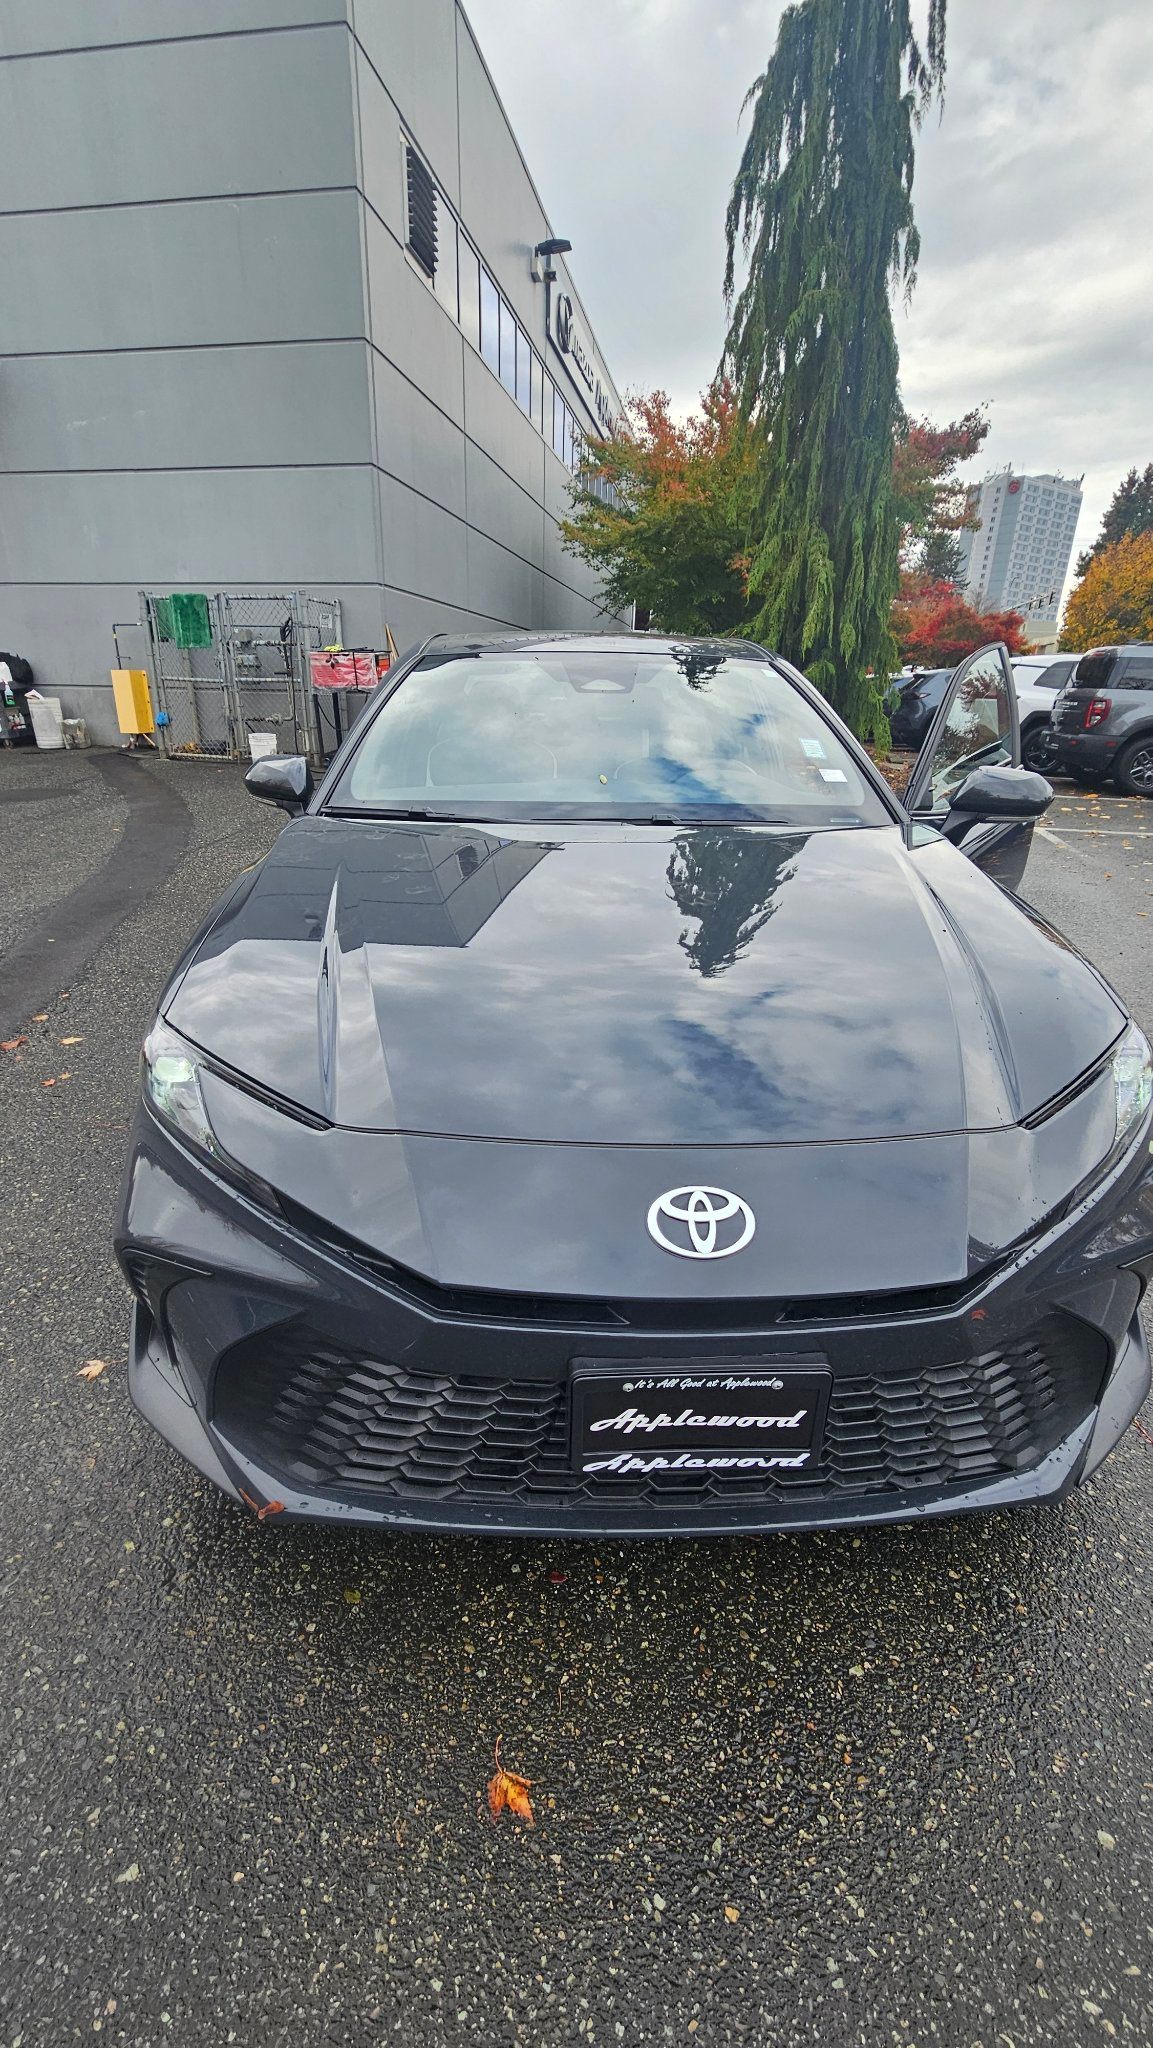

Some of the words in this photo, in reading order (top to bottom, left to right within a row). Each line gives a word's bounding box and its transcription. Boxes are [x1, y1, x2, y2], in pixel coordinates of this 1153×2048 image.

[634, 1379, 654, 1390] It's
[656, 1378, 679, 1389] All
[680, 1378, 706, 1390] Good
[706, 1379, 719, 1389] at
[720, 1376, 777, 1390] Applewood
[589, 1408, 808, 1434] Applewood
[582, 1453, 812, 1473] Applewood
